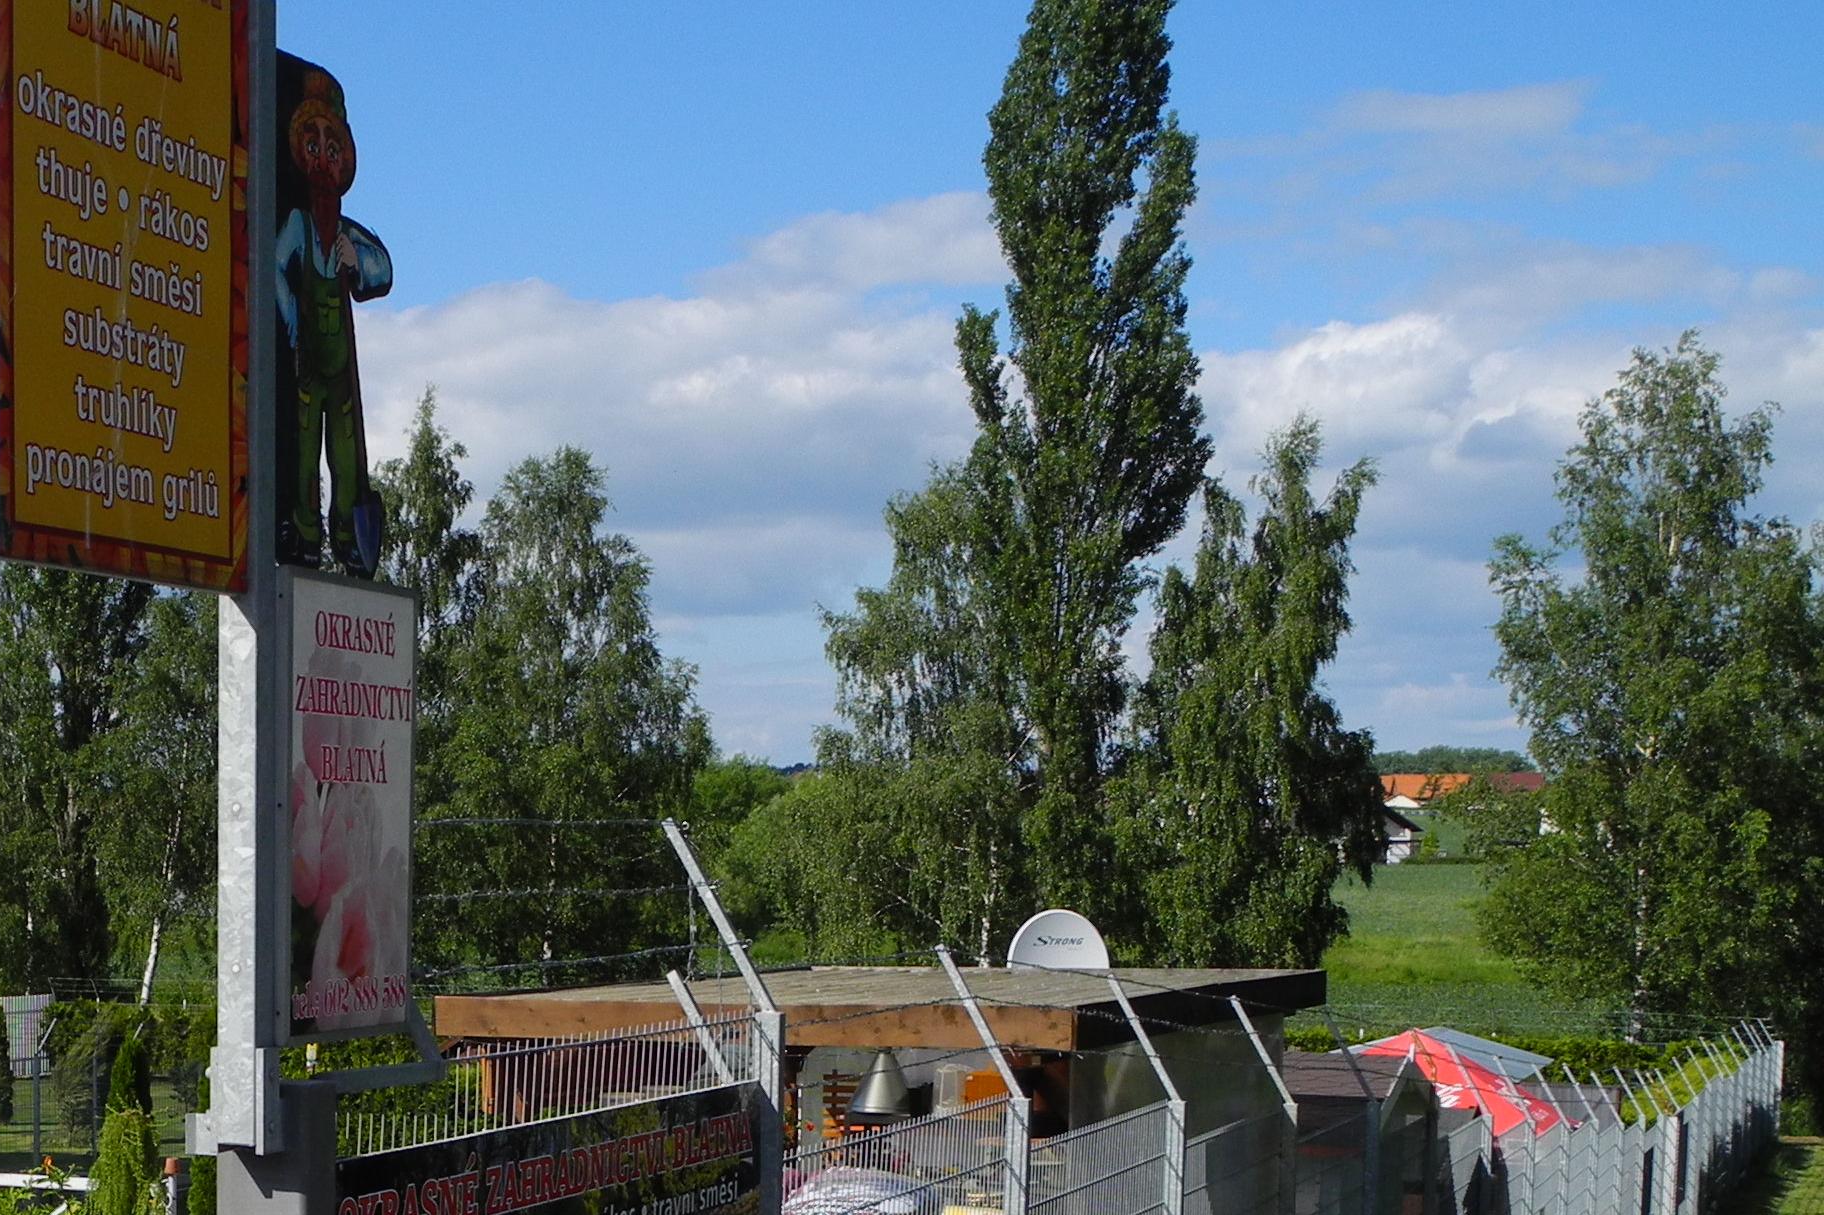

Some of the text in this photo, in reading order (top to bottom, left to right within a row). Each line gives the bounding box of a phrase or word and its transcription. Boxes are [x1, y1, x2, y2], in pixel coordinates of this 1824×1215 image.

[68, 0, 183, 82] BLATNÁ
[17, 69, 226, 202] okrasné dřeviny
[35, 146, 210, 252] thuje rákos
[42, 221, 203, 316] travní směsi
[63, 307, 186, 387] substráty
[74, 374, 177, 452] truhlíky
[26, 442, 220, 521] pronájem grilů
[314, 610, 396, 658] OKRASNÉ
[295, 674, 412, 723] ZAHRADNICTVÍ
[321, 740, 389, 784] BLATNÁ
[1032, 935, 1084, 946] STRONG
[324, 977, 349, 1016] 602
[353, 975, 378, 1011] 888
[382, 974, 406, 1009] 588
[699, 1172, 738, 1211] směsi
